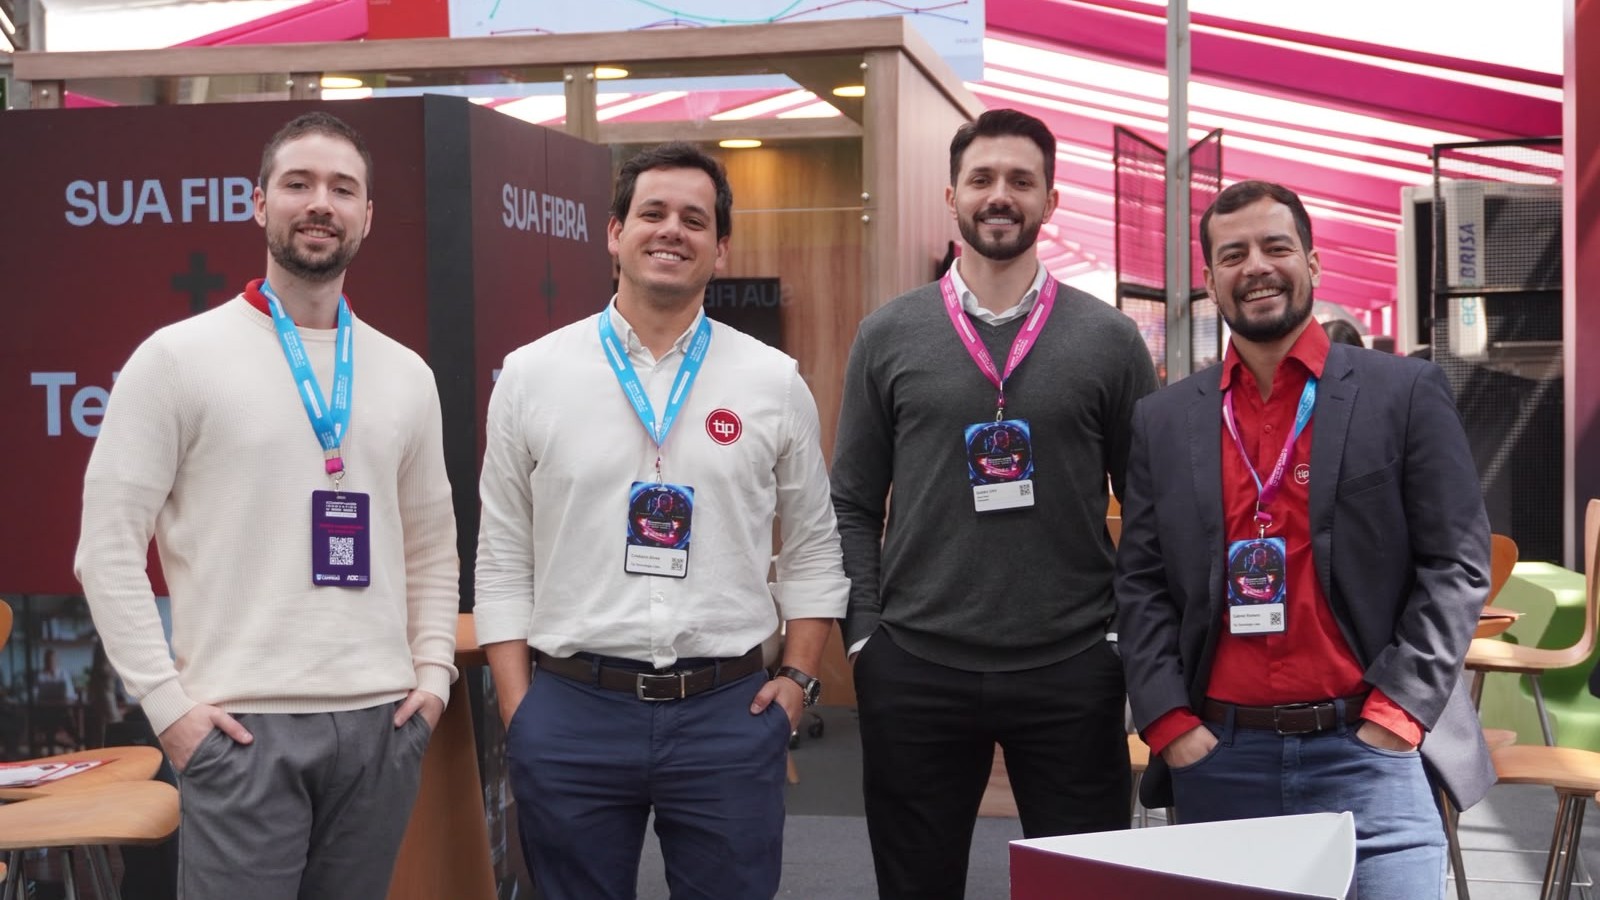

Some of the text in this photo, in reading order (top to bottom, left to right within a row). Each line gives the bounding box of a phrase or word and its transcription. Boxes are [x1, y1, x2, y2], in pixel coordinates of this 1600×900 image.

[64, 177, 257, 227] SUA FIB
[502, 183, 589, 243] SUA FIBRA
[30, 371, 121, 437] Te
[713, 419, 735, 438] tip
